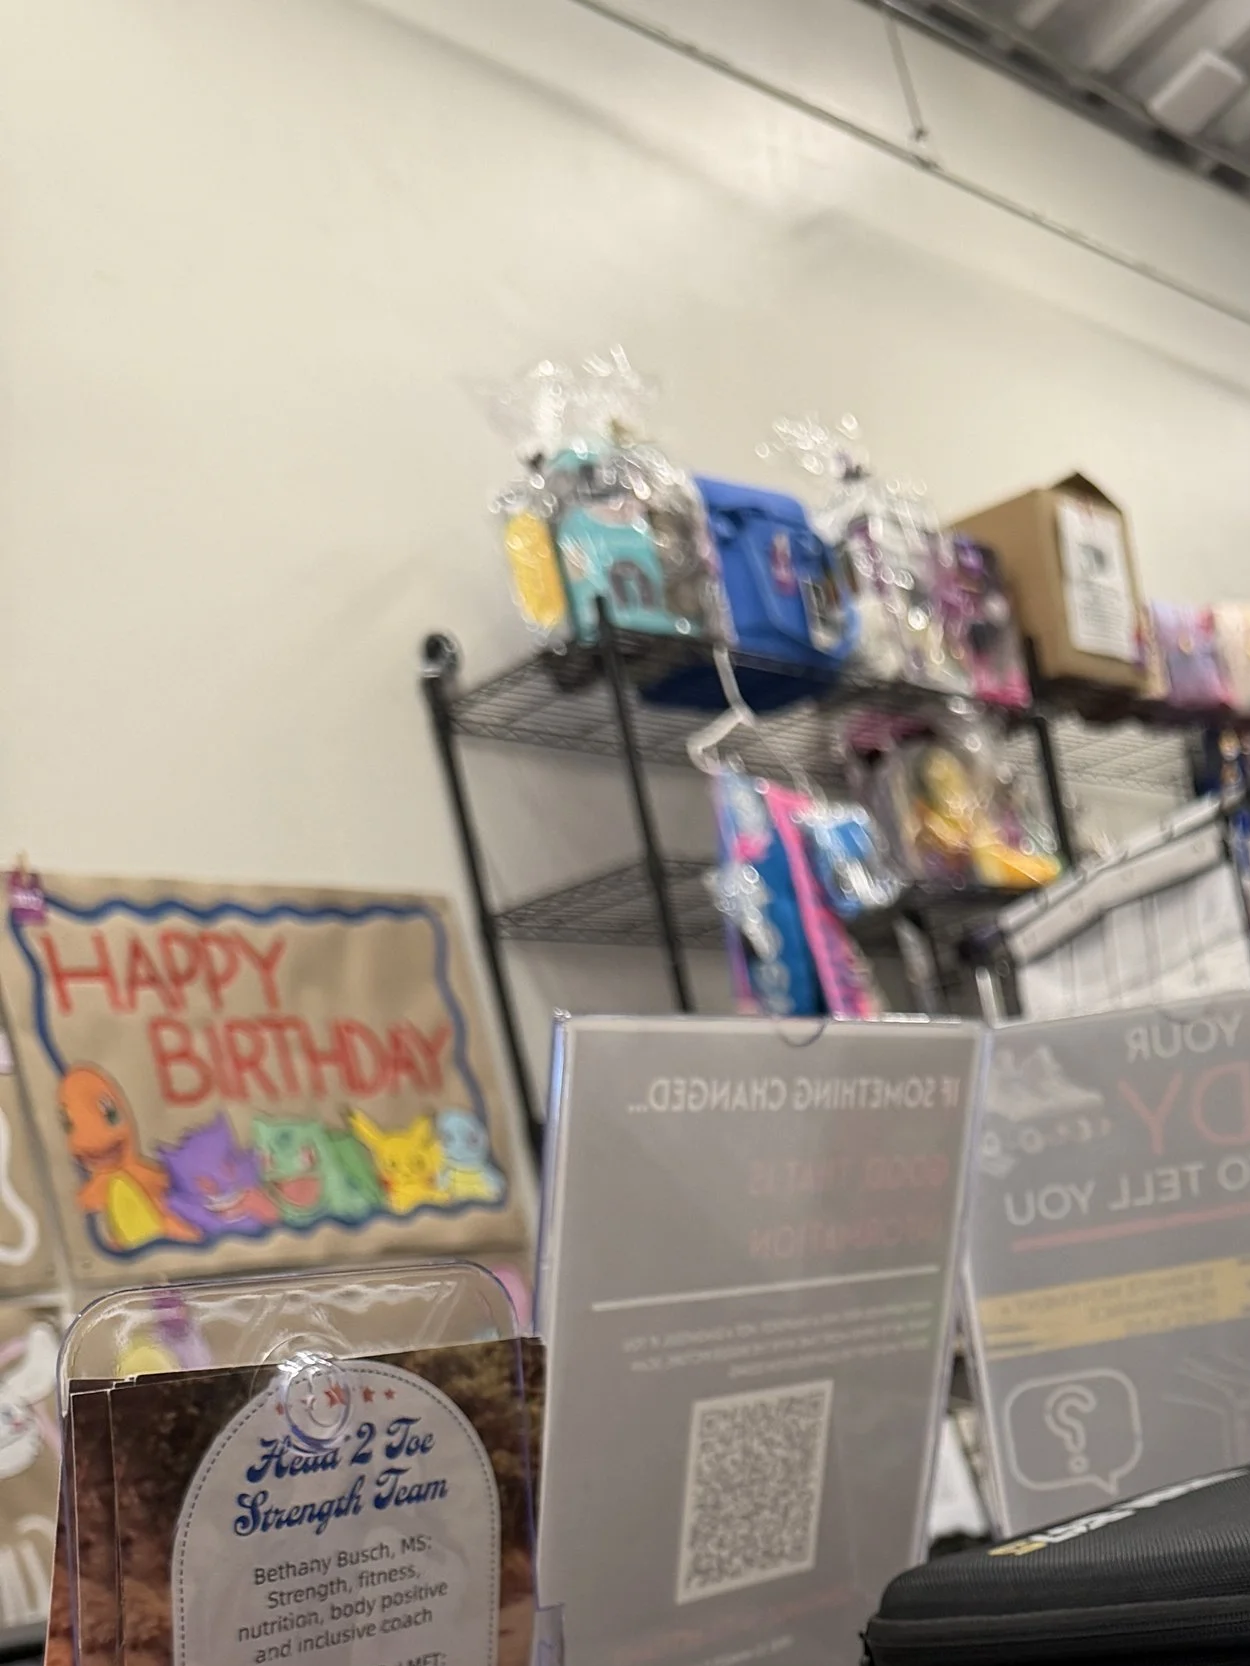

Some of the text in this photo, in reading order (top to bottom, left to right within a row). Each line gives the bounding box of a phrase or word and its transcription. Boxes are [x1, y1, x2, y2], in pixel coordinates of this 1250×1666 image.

[41, 930, 285, 1016] HAPPY
[148, 1017, 450, 1107] BIRTHDAY
[350, 1422, 376, 1465] 2
[384, 1417, 436, 1459] Toe
[234, 1467, 450, 1537] Strength Team
[254, 1534, 432, 1586] Bethany Busch, MS:
[268, 1564, 420, 1609] Strength, fitness,
[238, 1579, 448, 1643] nutrition, body positive
[255, 1609, 432, 1664] and inclusive coach
